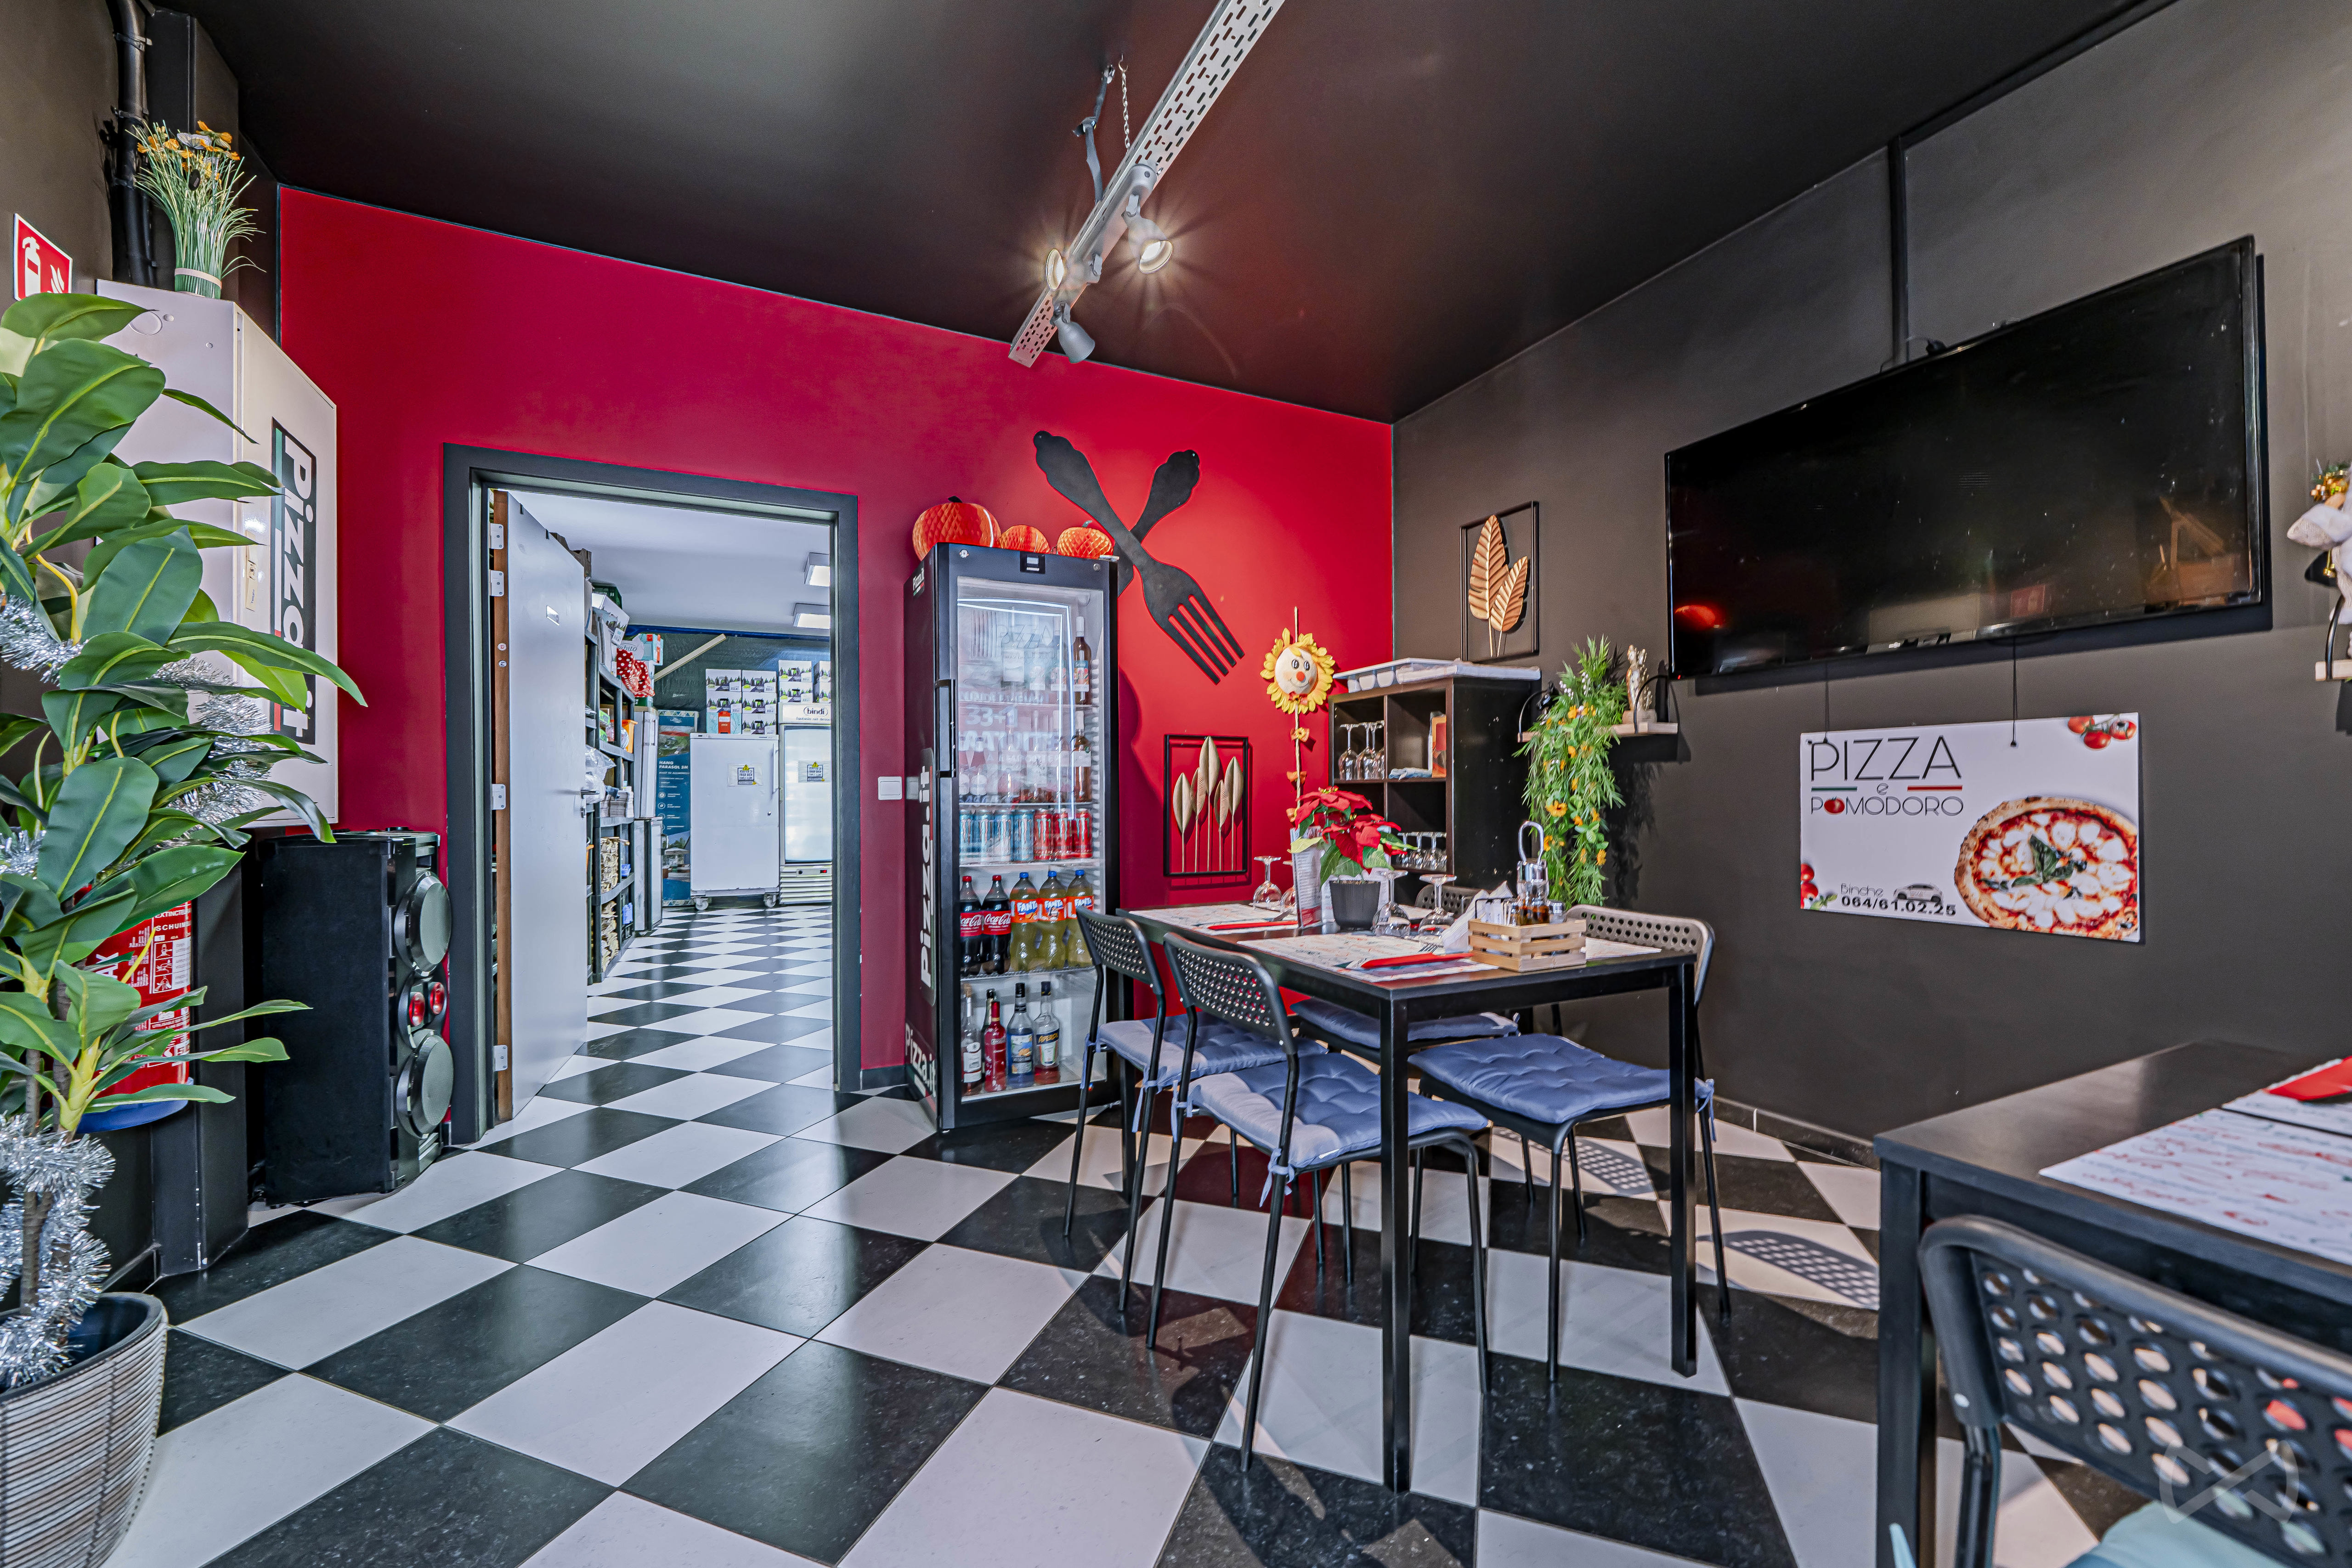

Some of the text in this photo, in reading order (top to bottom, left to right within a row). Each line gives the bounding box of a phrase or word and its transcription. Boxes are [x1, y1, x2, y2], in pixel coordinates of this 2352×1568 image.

[283, 435, 313, 737] Pizzat
[1811, 734, 1962, 782] PIZZA
[919, 766, 931, 987] Pizza.it
[905, 1022, 936, 1098] Pizza.it
